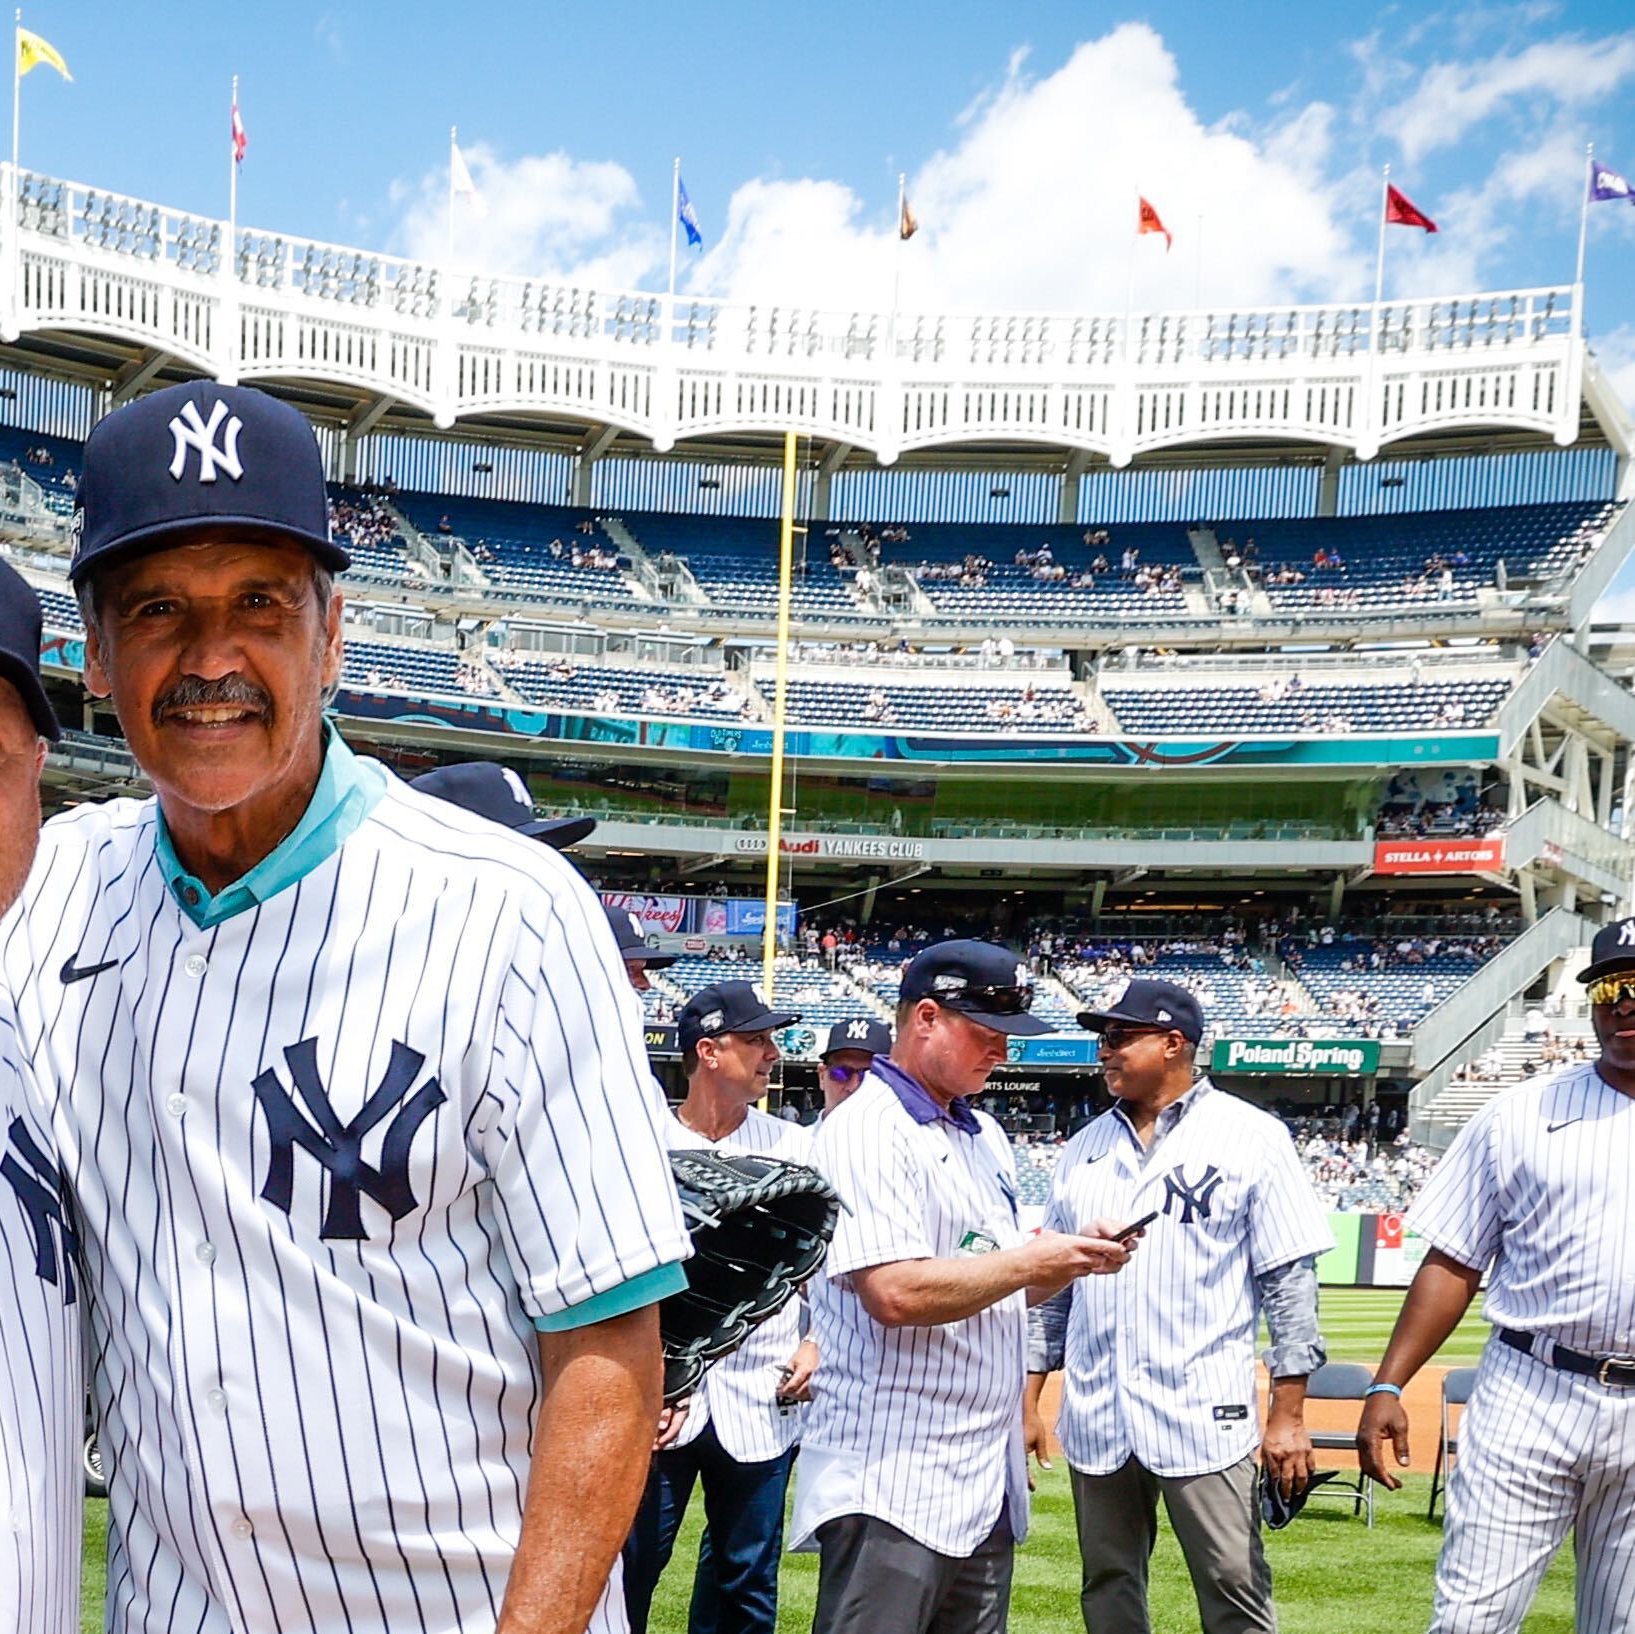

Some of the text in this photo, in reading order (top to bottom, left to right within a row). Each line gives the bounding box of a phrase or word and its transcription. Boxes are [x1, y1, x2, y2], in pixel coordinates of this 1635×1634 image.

[169, 399, 244, 482] NY
[826, 839, 888, 857] YANKEES
[889, 841, 924, 858] CLUB
[1384, 849, 1494, 863] STELLA ARTOIS
[846, 1020, 871, 1040] NY
[1227, 1040, 1364, 1070] Poland Spring
[1004, 1082, 1041, 1092] LOUNGE
[251, 1036, 448, 1240] NY
[1162, 1163, 1224, 1224] NY
